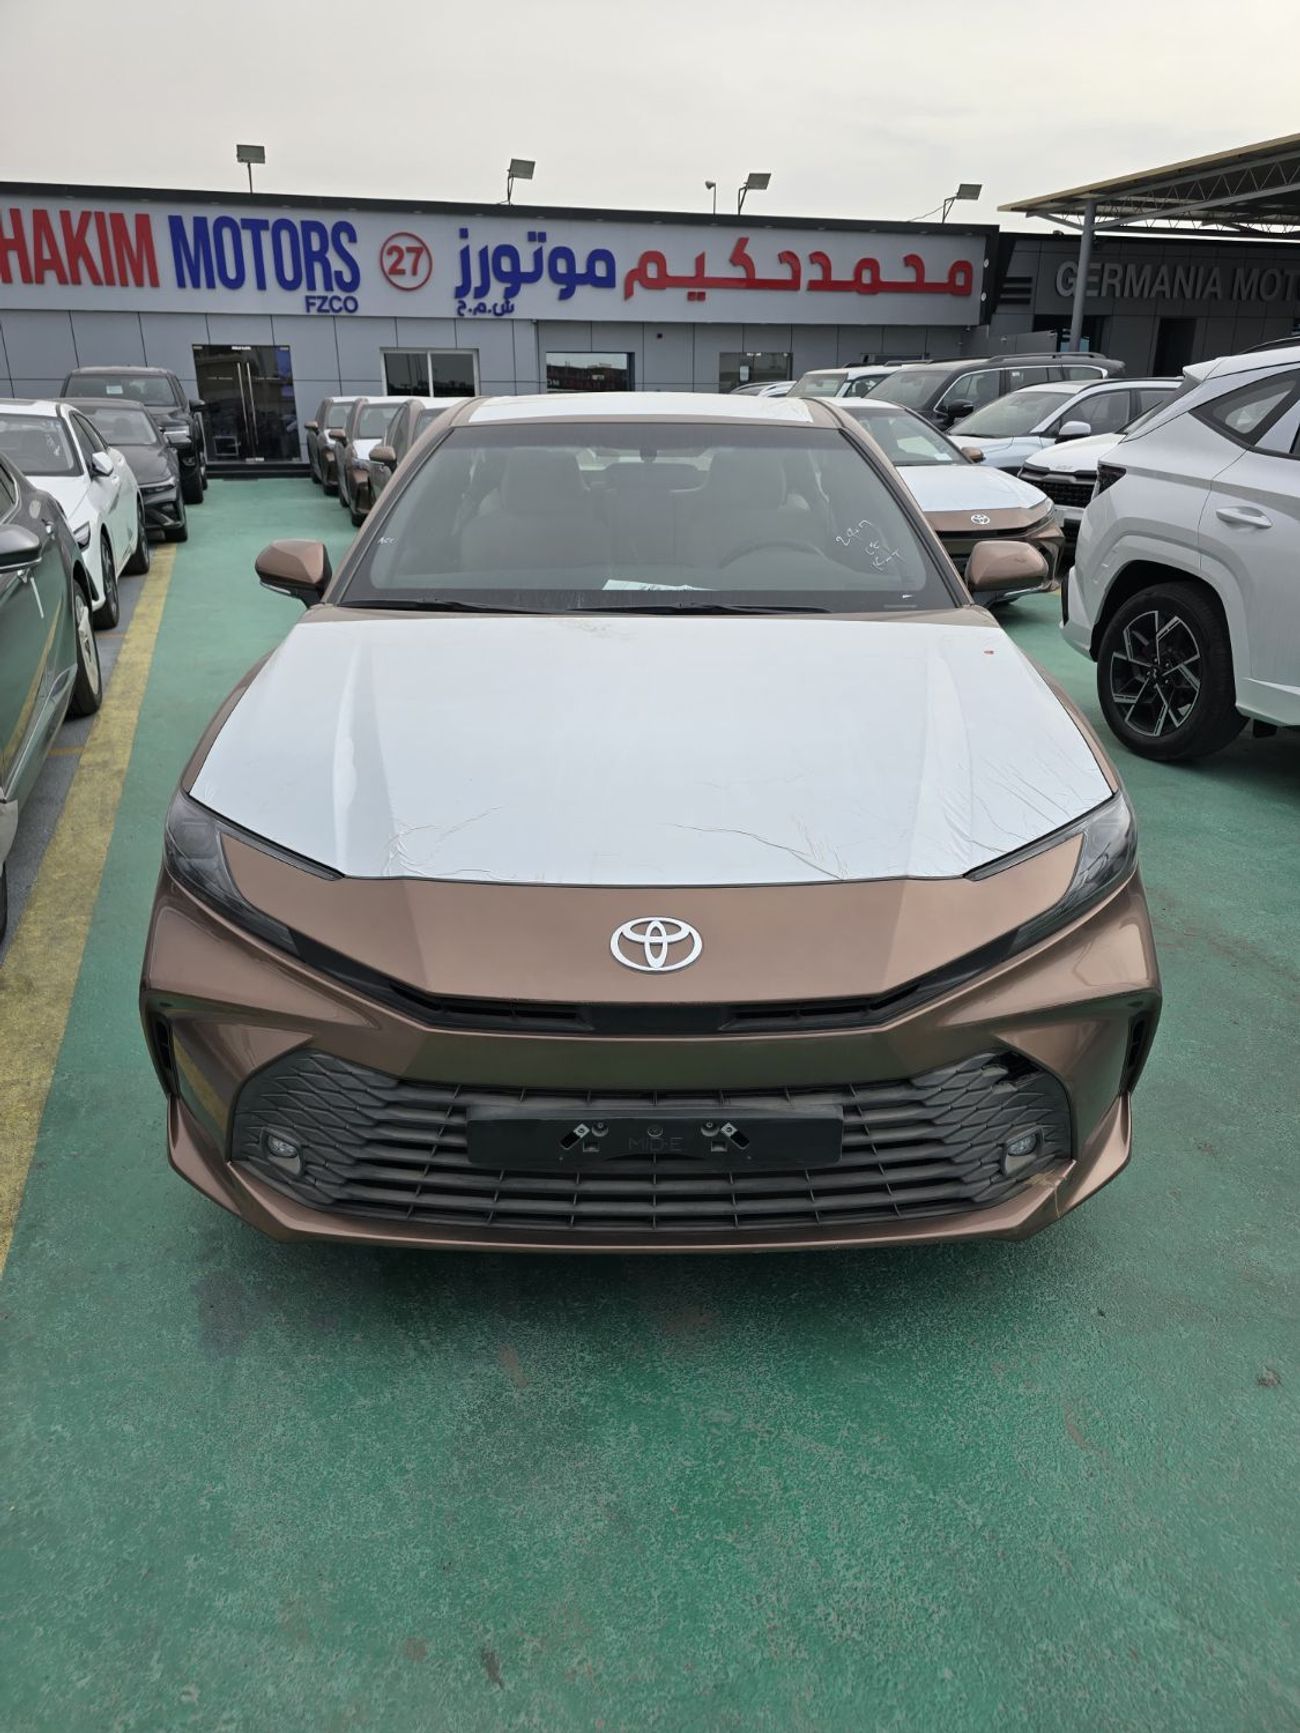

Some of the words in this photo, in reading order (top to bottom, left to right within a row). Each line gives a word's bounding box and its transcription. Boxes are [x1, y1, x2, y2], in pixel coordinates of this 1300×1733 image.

[0, 208, 160, 288] HAKIM
[168, 214, 361, 293] MOTORS
[386, 245, 424, 276] 27
[454, 228, 616, 301] موتورز
[1055, 260, 1222, 299] GERMANIA
[305, 296, 358, 314] FZCO
